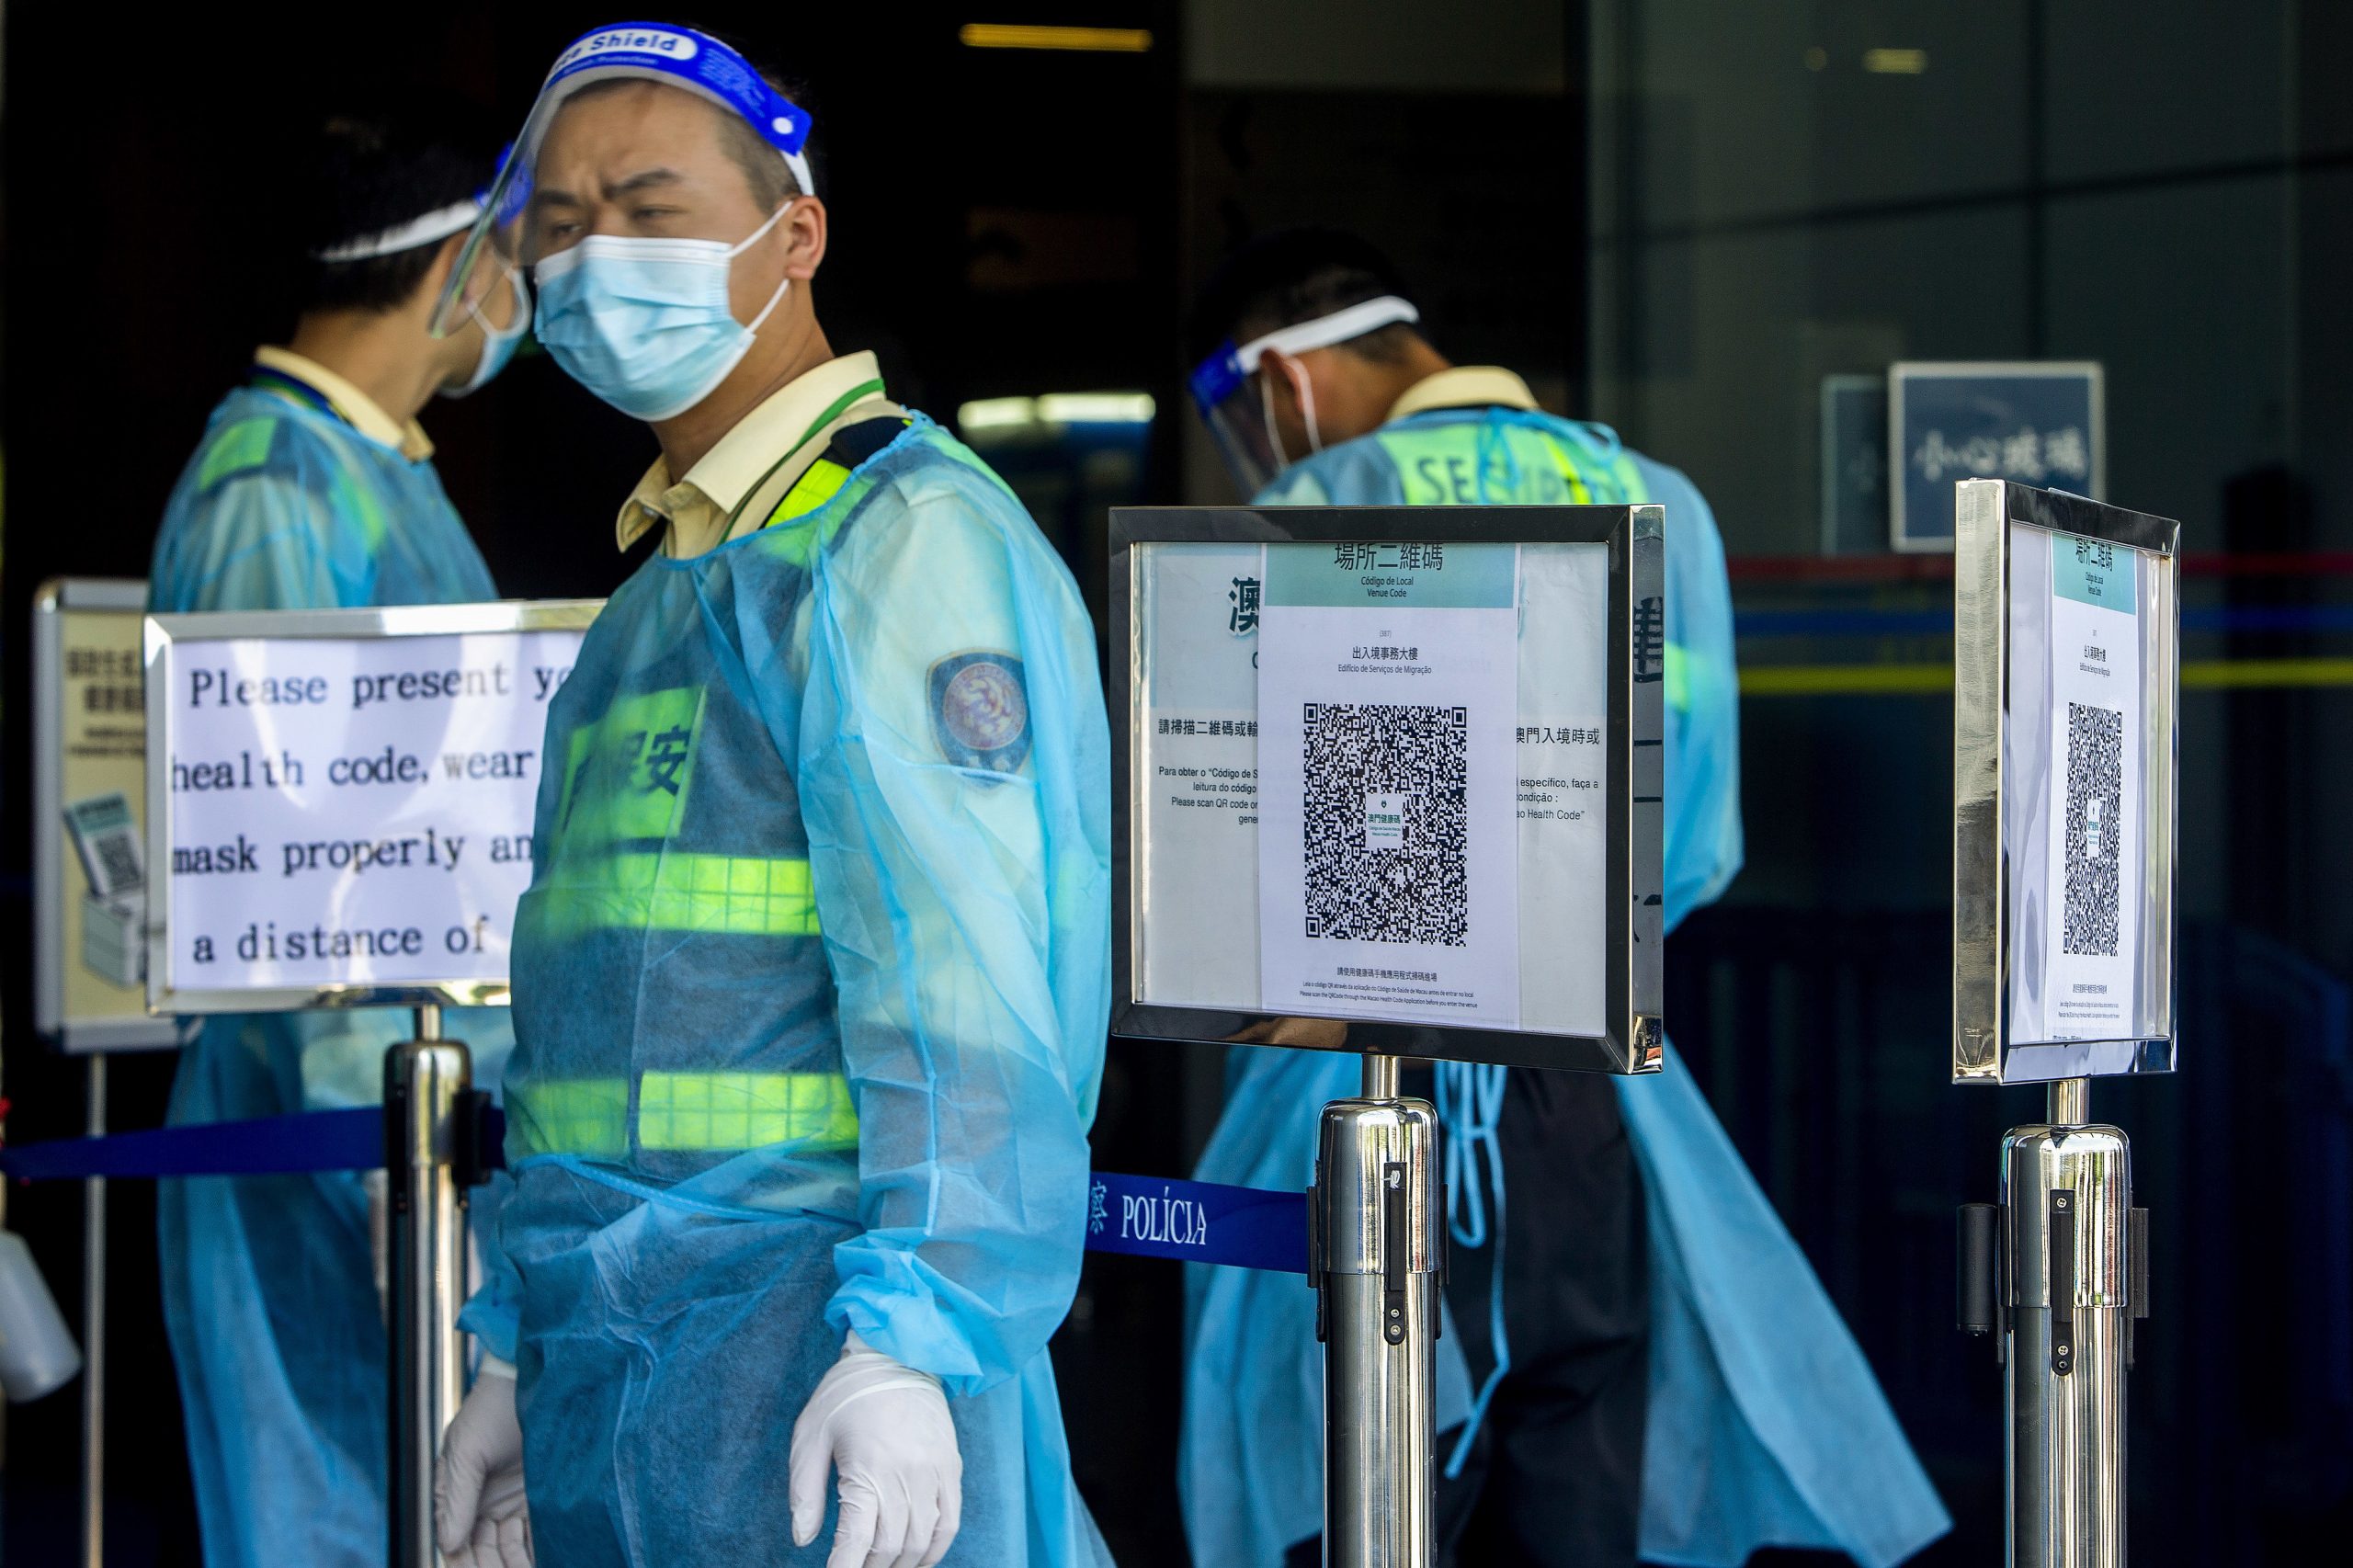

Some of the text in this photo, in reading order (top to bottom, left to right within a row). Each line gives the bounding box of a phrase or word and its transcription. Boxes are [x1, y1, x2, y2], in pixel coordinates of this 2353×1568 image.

[590, 33, 677, 51] Shield
[1335, 542, 1443, 571] 場所二維碼
[1361, 576, 1414, 587] Código de Local
[1368, 588, 1406, 597] Venue Code
[1352, 646, 1418, 660] 出入境事務大樓
[1360, 665, 1368, 673] de
[1369, 665, 1393, 675] Serviços
[1395, 665, 1403, 674] de
[1404, 665, 1432, 676] Migração
[189, 667, 328, 708] Please
[352, 663, 509, 710] present
[173, 745, 534, 791] health code, wear
[1158, 766, 1176, 776] Para
[1178, 767, 1199, 777] obter
[1241, 769, 1251, 778] de
[1193, 781, 1257, 794] leitura do código
[1572, 778, 1591, 790] faça
[1593, 780, 1598, 789] a
[1172, 797, 1195, 807] Please
[1197, 800, 1213, 808] scan
[1216, 798, 1228, 808] QR
[1230, 800, 1248, 809] code
[1528, 809, 1554, 819] Health
[173, 833, 258, 874] mask
[283, 826, 464, 878] properly
[193, 913, 489, 963] a distance of
[1120, 1186, 1207, 1245] POLÍCIA
